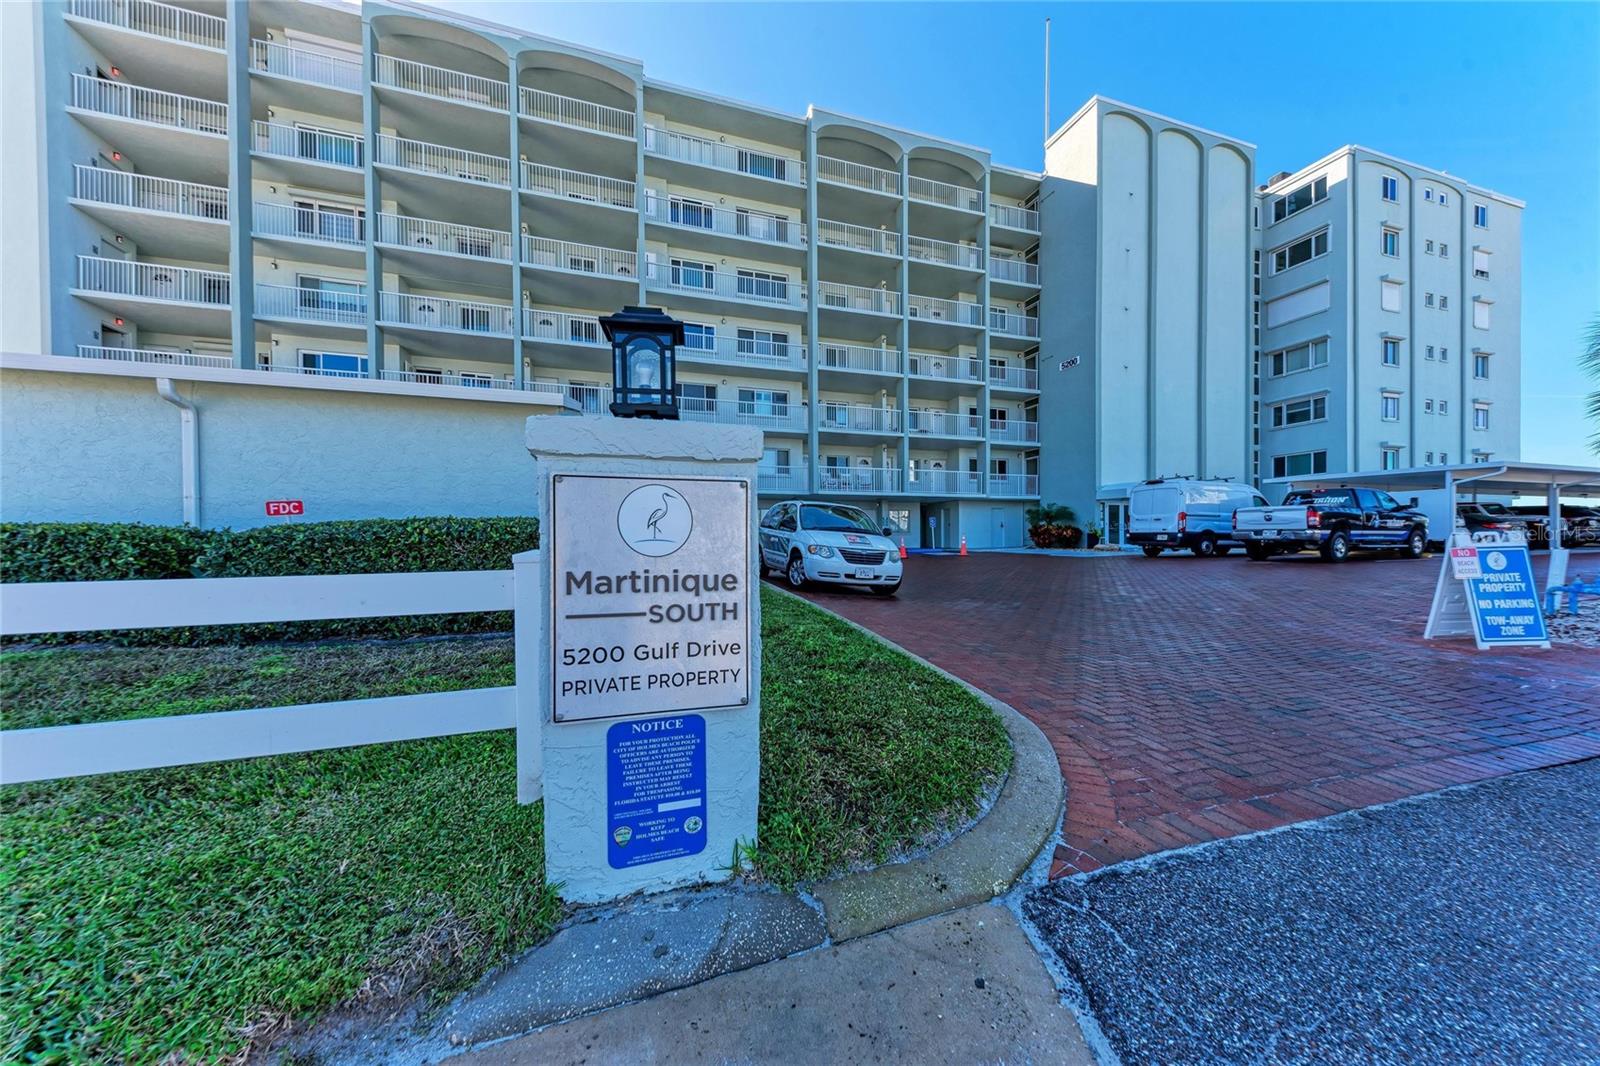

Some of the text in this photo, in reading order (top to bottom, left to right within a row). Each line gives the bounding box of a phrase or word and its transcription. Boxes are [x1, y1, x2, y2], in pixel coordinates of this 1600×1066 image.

[1061, 358, 1078, 370] 5200
[269, 503, 299, 514] FDC
[1484, 573, 1521, 582] PRIVATE
[565, 569, 738, 596] Martinique
[1479, 583, 1526, 592] PROPERTY
[1480, 599, 1534, 609] NO PARKING
[648, 602, 738, 623] SOUTH
[1485, 616, 1534, 625] TOW-AWAY
[1501, 626, 1525, 635] ZONE
[563, 640, 741, 666] 5200 Gulf Drive
[562, 668, 741, 696] PRIVATE PROPERTY
[632, 719, 684, 733] NOTICE
[649, 735, 684, 743] PROTECTION
[661, 745, 695, 753] AUTHORIZED
[639, 819, 667, 827] WORKING
[636, 832, 660, 840] HOLMES
